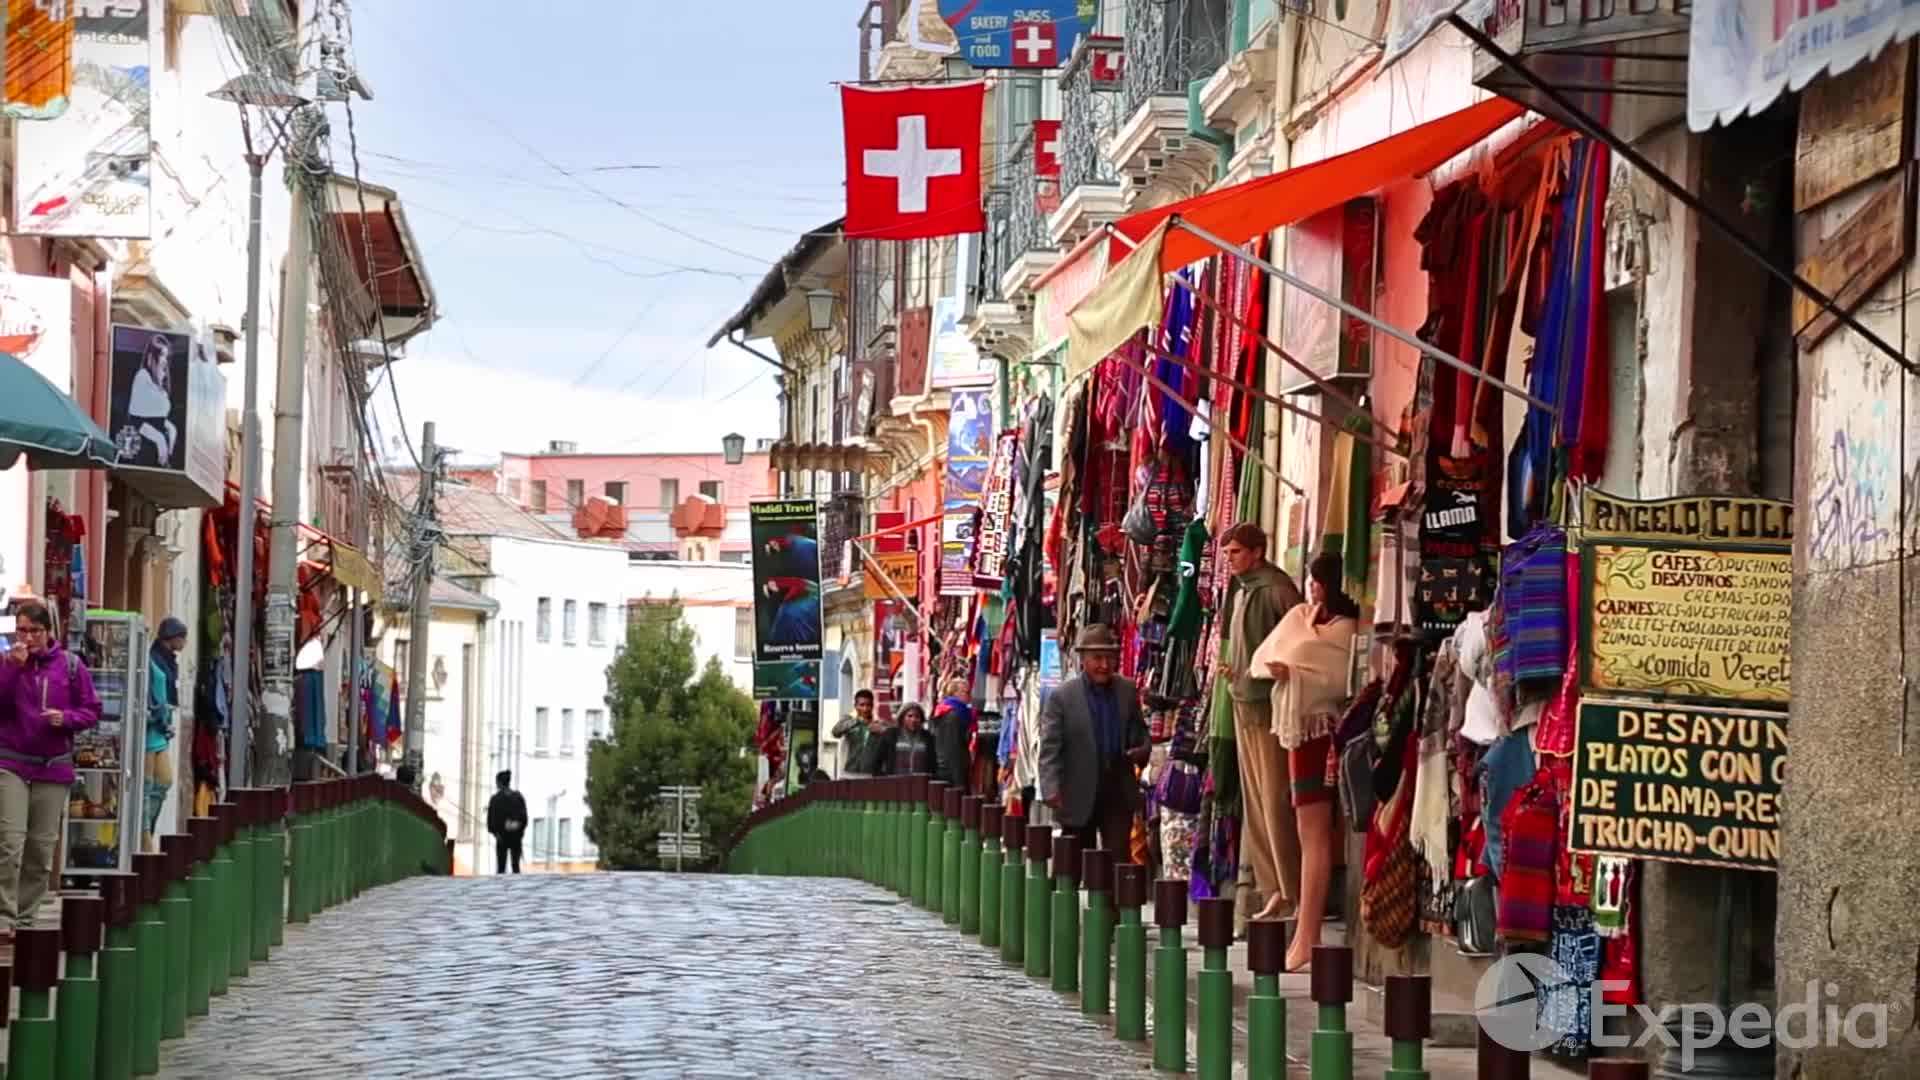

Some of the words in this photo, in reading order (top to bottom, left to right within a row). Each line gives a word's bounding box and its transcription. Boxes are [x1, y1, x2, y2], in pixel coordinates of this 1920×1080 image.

[970, 15, 1008, 30] BAKERY
[970, 44, 1000, 57] FOOD
[974, 34, 991, 44] and
[751, 503, 782, 514] Madidi
[784, 503, 814, 513] Travel
[1426, 506, 1476, 529] LLAMA
[1595, 499, 1700, 535] ANGELO
[1643, 649, 1710, 678] Comida
[1617, 710, 1788, 749] DESAYUN
[1586, 742, 1688, 778] PLATOS
[1700, 750, 1763, 784] CON
[1581, 778, 1617, 809] DE
